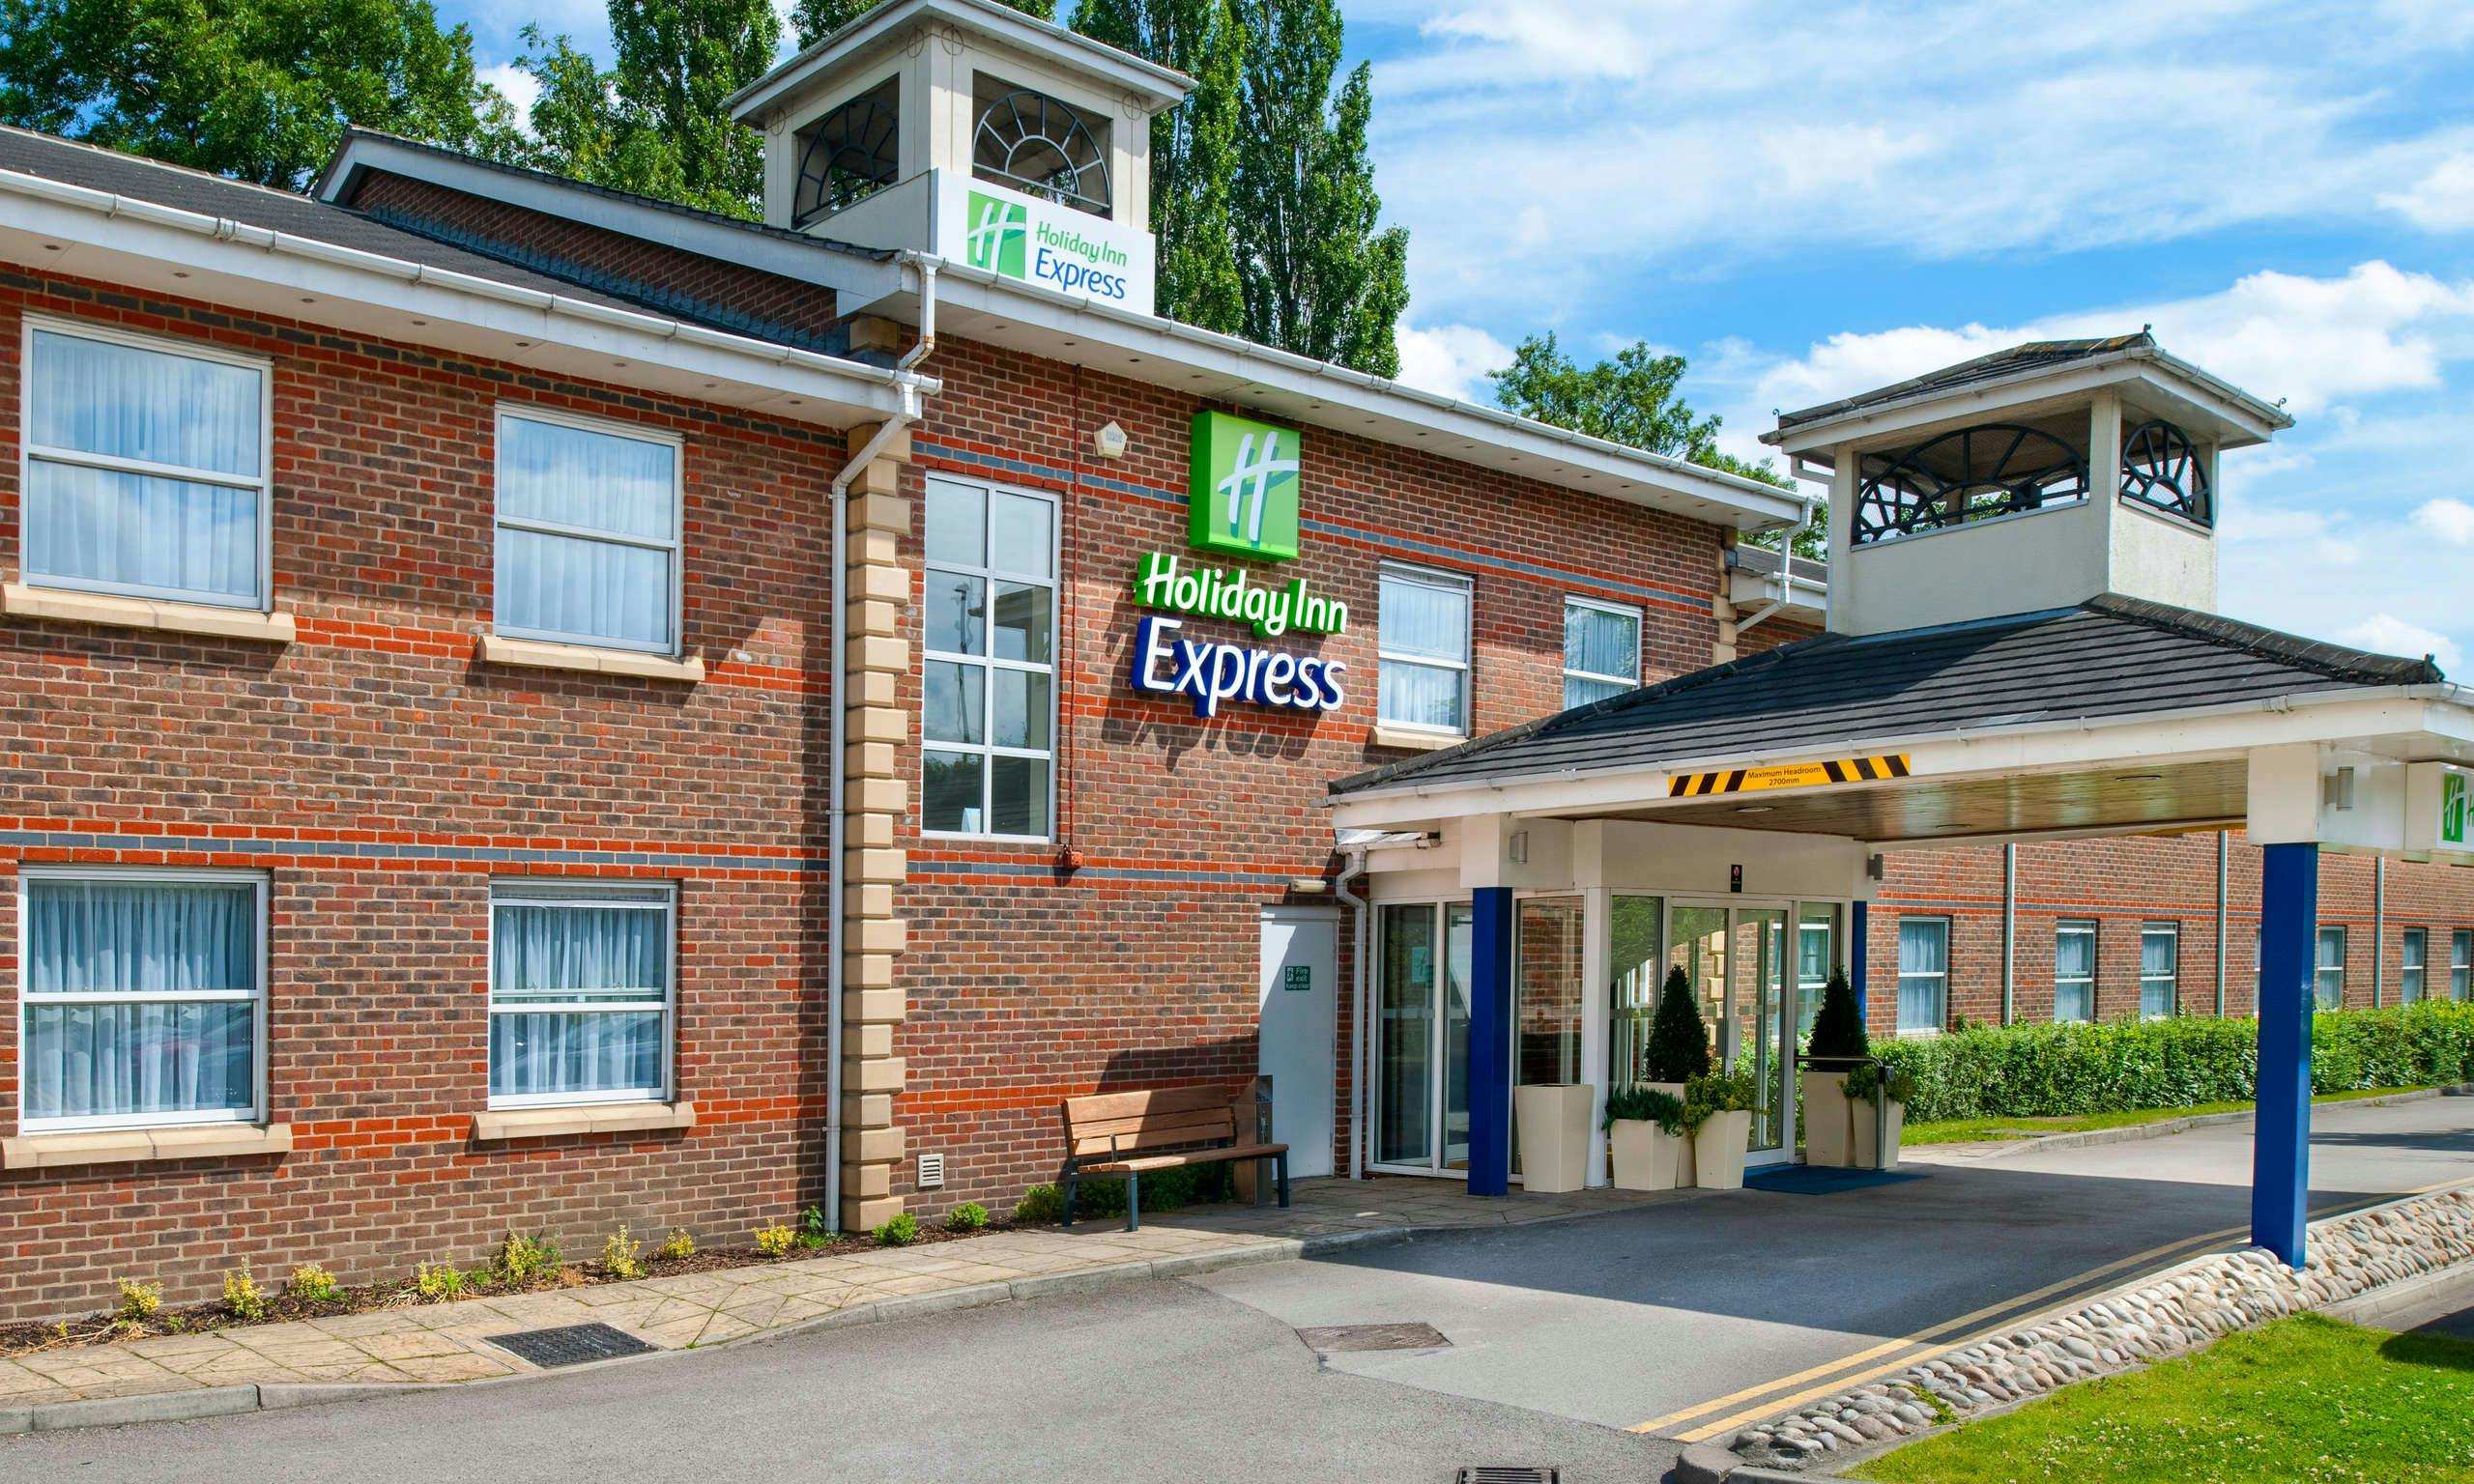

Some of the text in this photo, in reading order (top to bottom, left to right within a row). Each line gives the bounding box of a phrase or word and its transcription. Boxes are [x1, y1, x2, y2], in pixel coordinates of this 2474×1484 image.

[1036, 220, 1128, 268] Holiday Inn
[1035, 247, 1127, 300] Express
[1140, 551, 1349, 637] Holiday Inn
[1140, 615, 1348, 718] Express
[1747, 766, 1822, 779] Maximum Headroom
[1769, 778, 1799, 786] 2700mm
